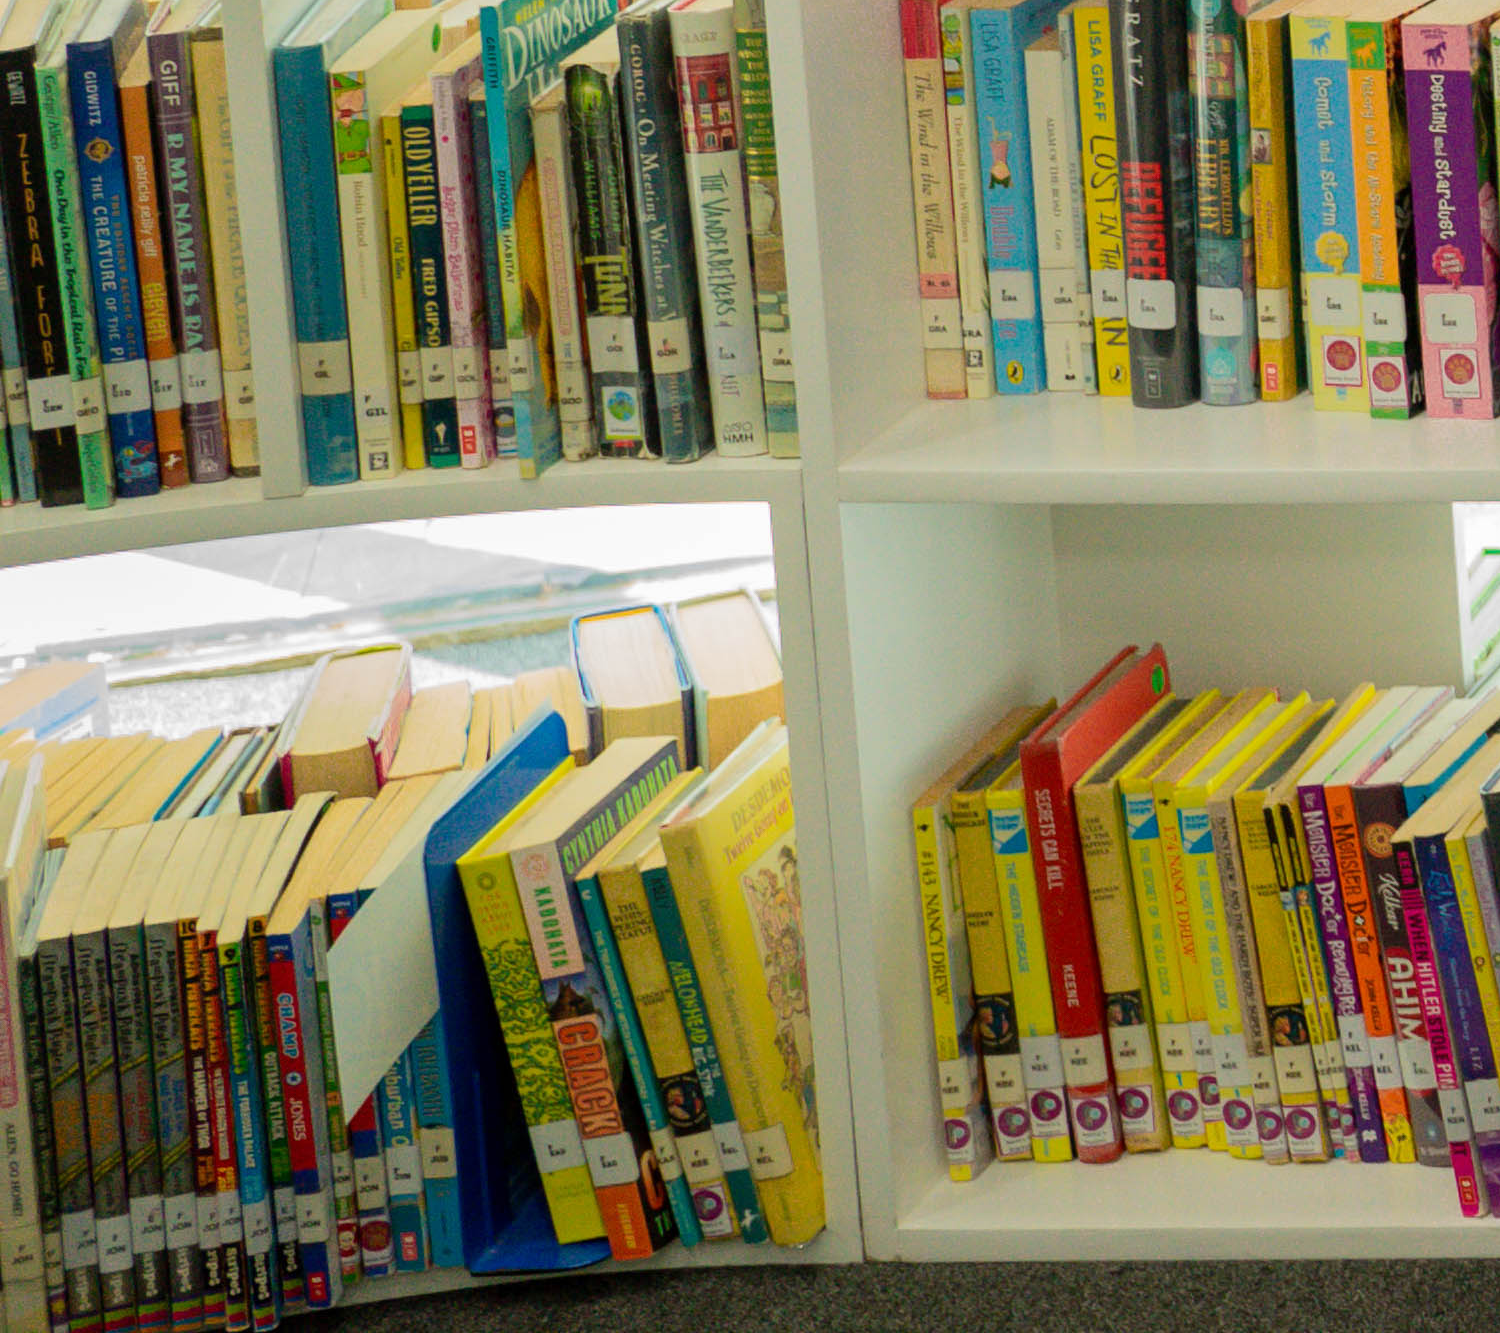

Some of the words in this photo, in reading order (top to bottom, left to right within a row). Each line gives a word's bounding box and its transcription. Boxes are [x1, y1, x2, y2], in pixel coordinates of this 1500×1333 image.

[1088, 20, 1105, 61] LISA
[159, 58, 182, 107] GIFF
[1091, 63, 1107, 123] GRAFF
[405, 125, 429, 164] OLD
[405, 165, 439, 229] YELLER
[1123, 163, 1167, 280] REFUGEE
[722, 433, 755, 444] HMH
[563, 803, 615, 876] CYNTHIA
[613, 754, 678, 829] KADOHATA
[1034, 789, 1053, 833] SECRETS
[1040, 837, 1057, 858] CAN
[1044, 861, 1064, 891] KILL
[535, 884, 567, 973] KADOHATA
[1062, 963, 1079, 1008] KEENE
[278, 992, 299, 1059] CHAMP
[556, 1023, 621, 1139] CRACK
